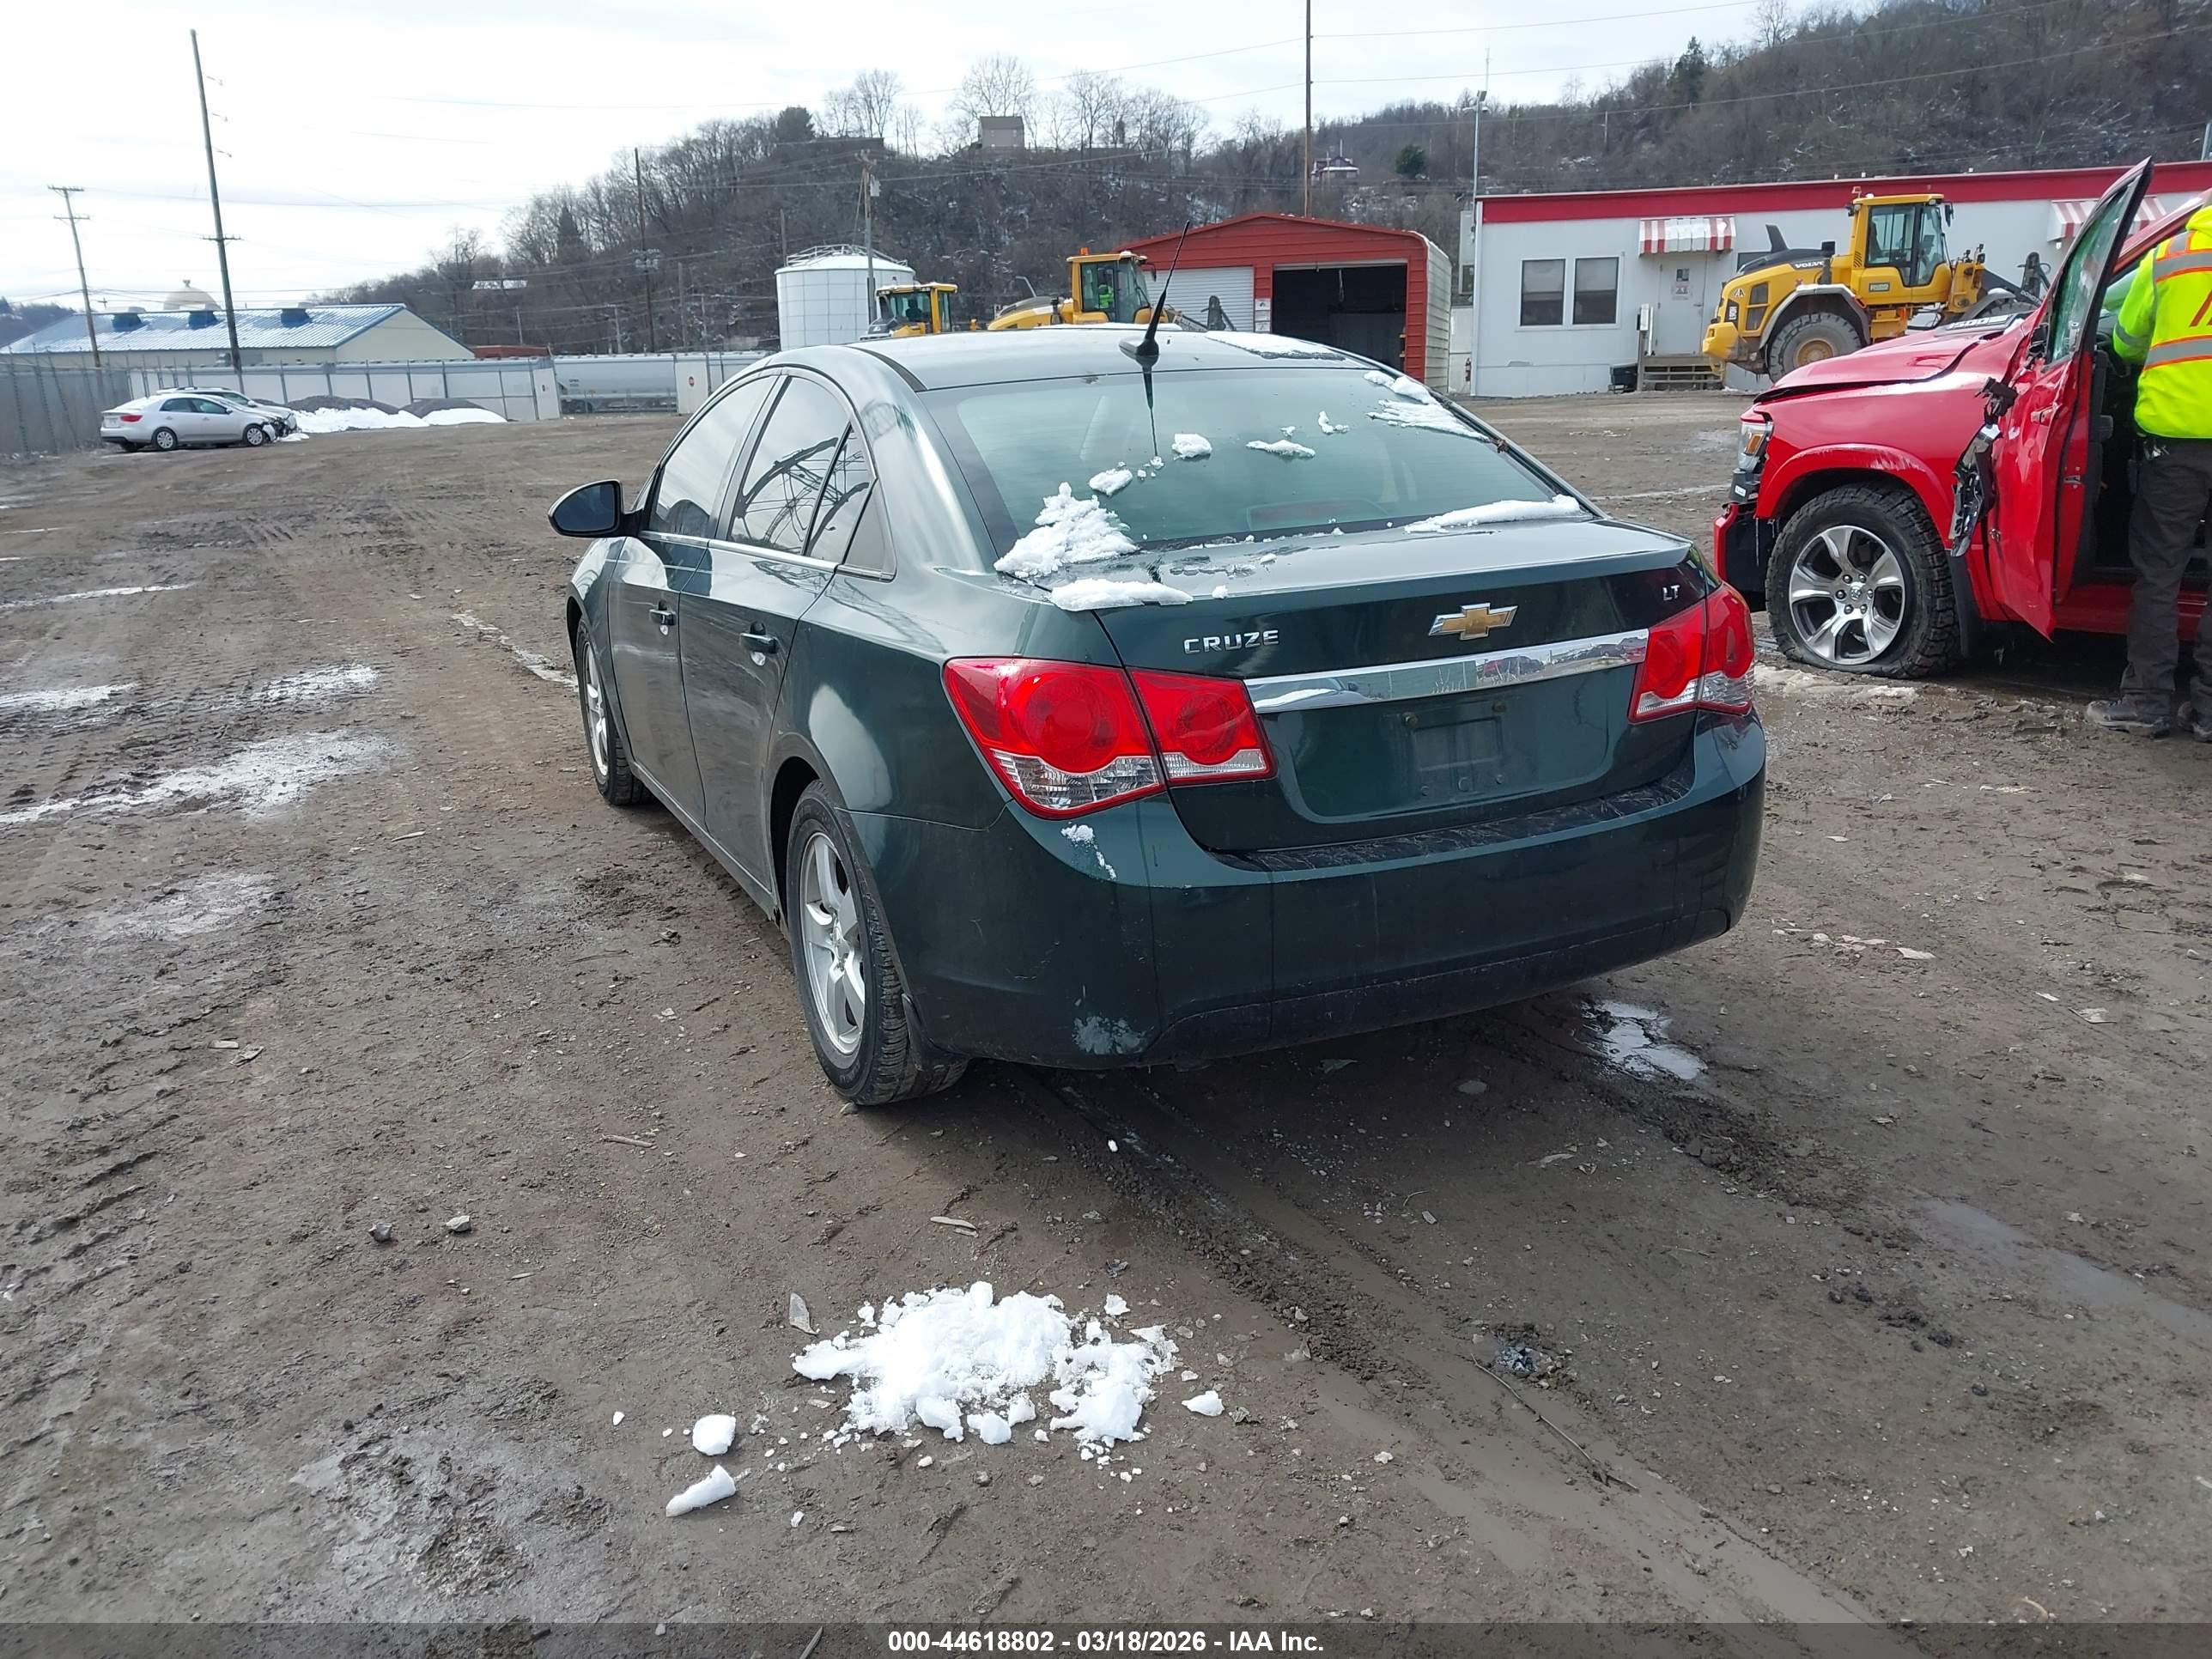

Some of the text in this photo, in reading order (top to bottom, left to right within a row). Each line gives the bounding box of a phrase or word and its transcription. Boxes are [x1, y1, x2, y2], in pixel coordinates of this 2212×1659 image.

[1948, 317, 1990, 329] 1500
[1662, 584, 1680, 601] LT
[1183, 629, 1279, 654] CRUZE
